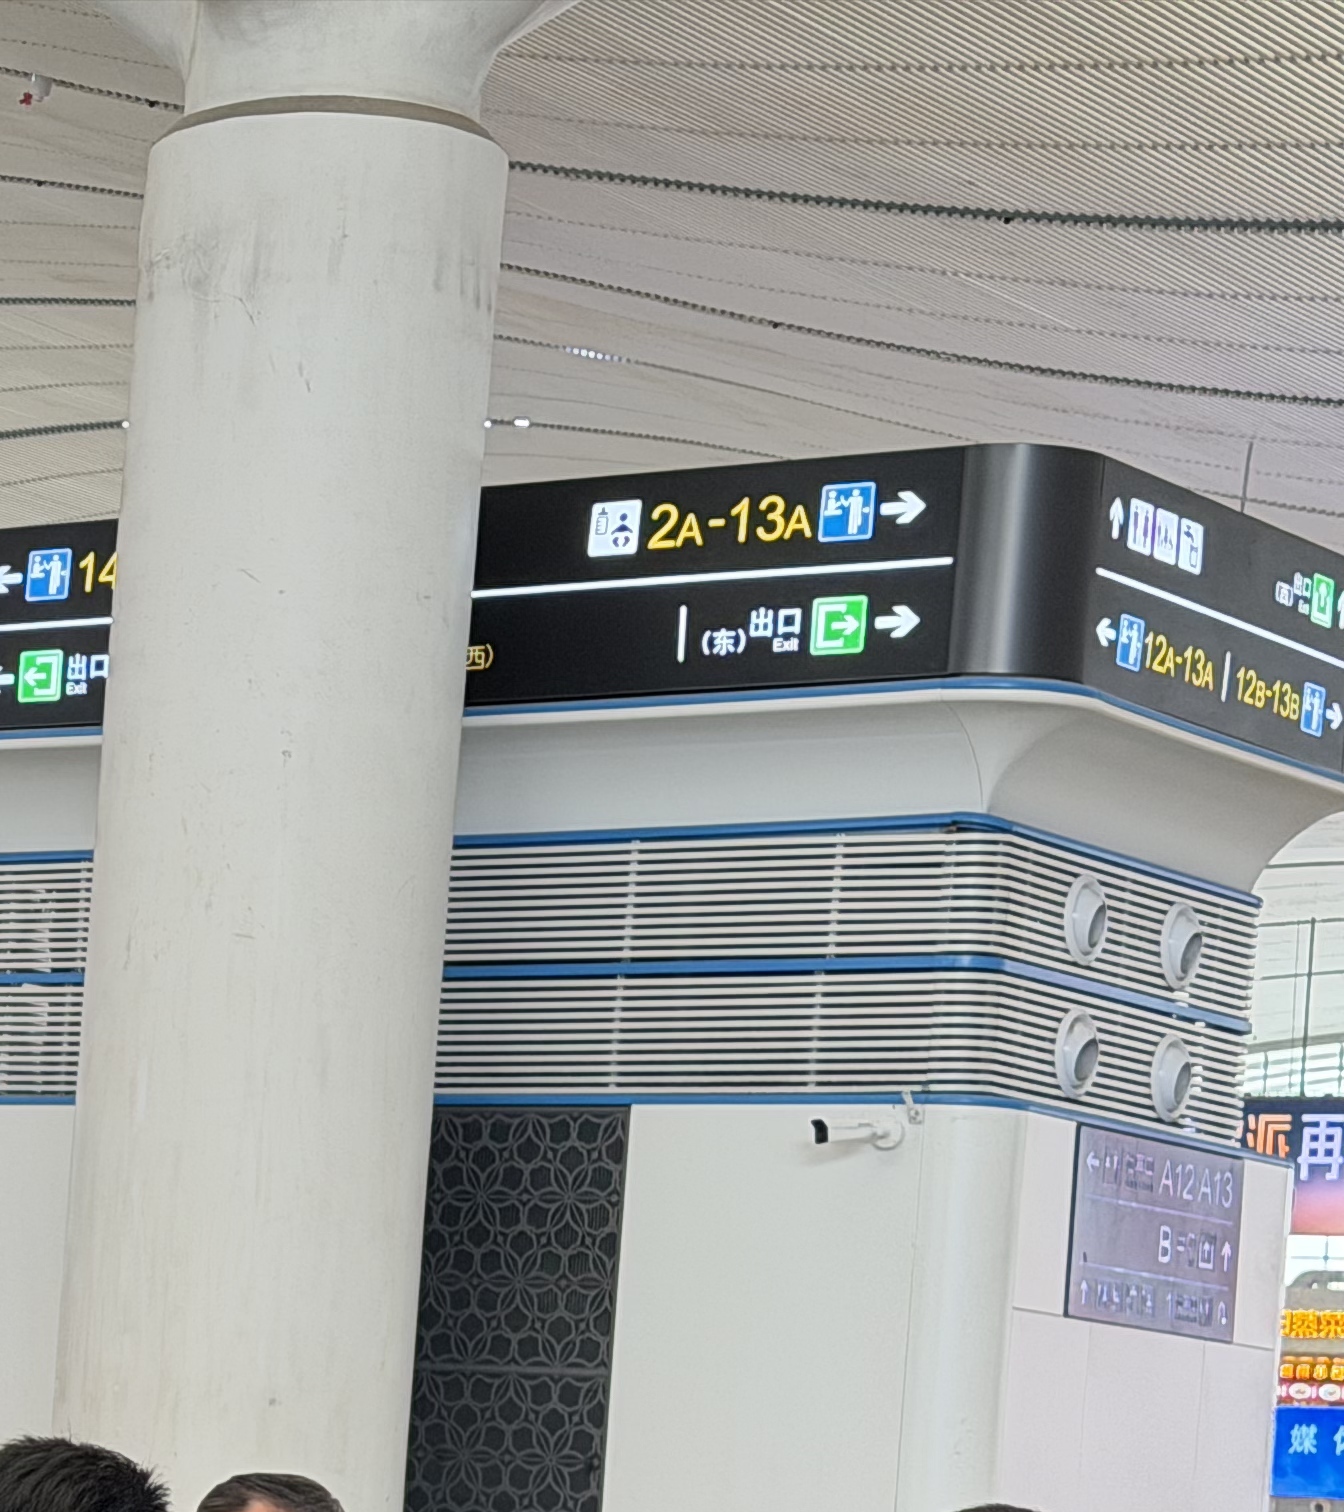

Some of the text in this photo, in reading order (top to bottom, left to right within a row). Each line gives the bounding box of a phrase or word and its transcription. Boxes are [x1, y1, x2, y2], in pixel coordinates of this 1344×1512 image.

[647, 494, 813, 550] 2A-13A
[749, 606, 802, 638] 出口
[66, 653, 110, 681] 出口
[1145, 630, 1300, 721] 12A-13A 12B-13B
[1157, 1225, 1172, 1264] B
